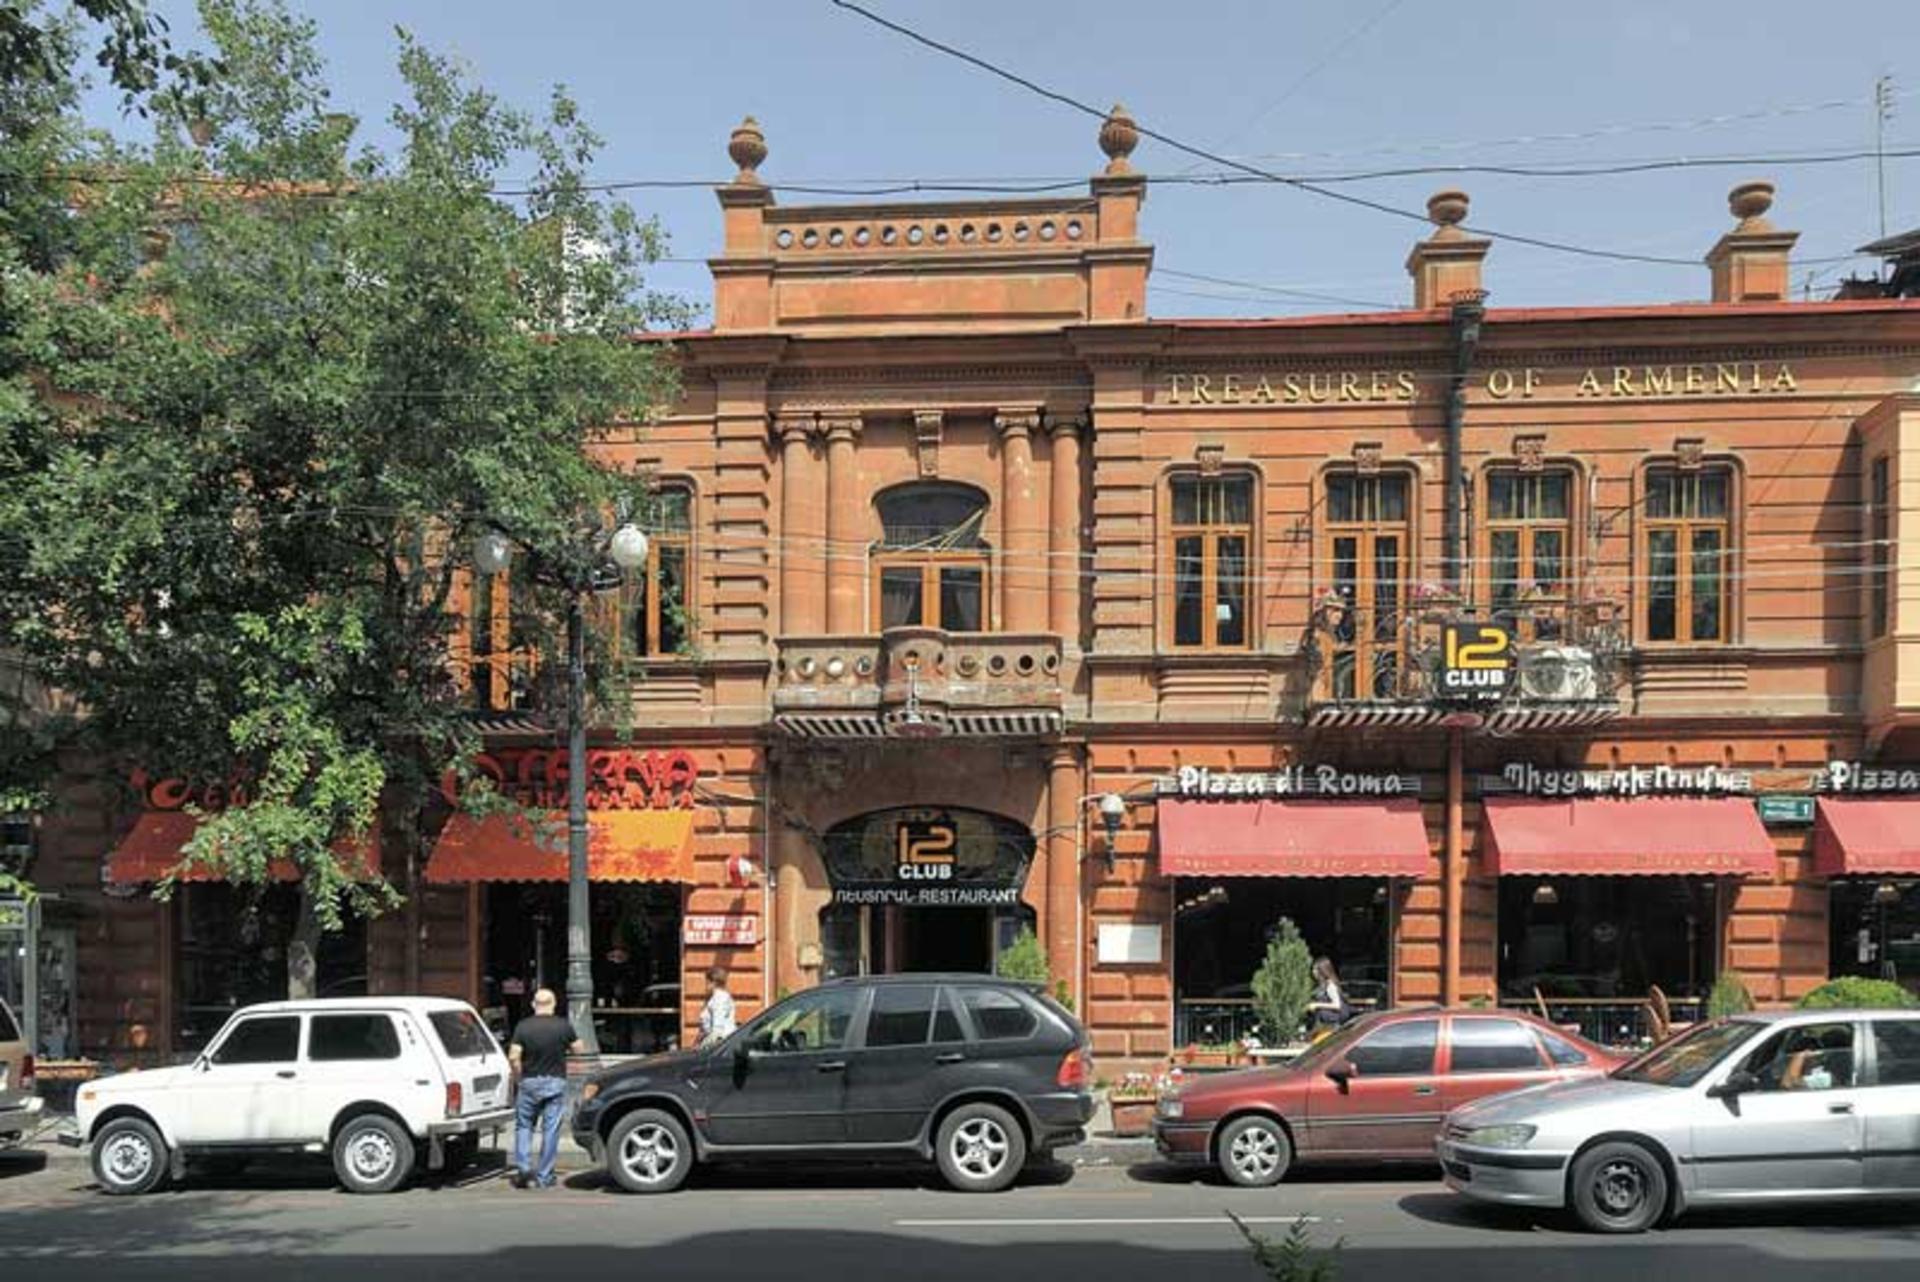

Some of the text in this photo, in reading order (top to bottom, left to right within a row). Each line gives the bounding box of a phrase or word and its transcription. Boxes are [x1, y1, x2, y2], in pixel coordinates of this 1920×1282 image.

[1166, 362, 1798, 404] TREASURES OF ARMENIA
[1446, 627, 1508, 669] 12
[1446, 669, 1505, 687] CLUB
[1177, 765, 1265, 795] Pizza
[1315, 764, 1403, 795] Roma
[1829, 760, 1919, 791] Pizza
[899, 825, 955, 864] 12
[898, 863, 952, 880] CLUB
[919, 888, 1019, 904] RESTAURANT
